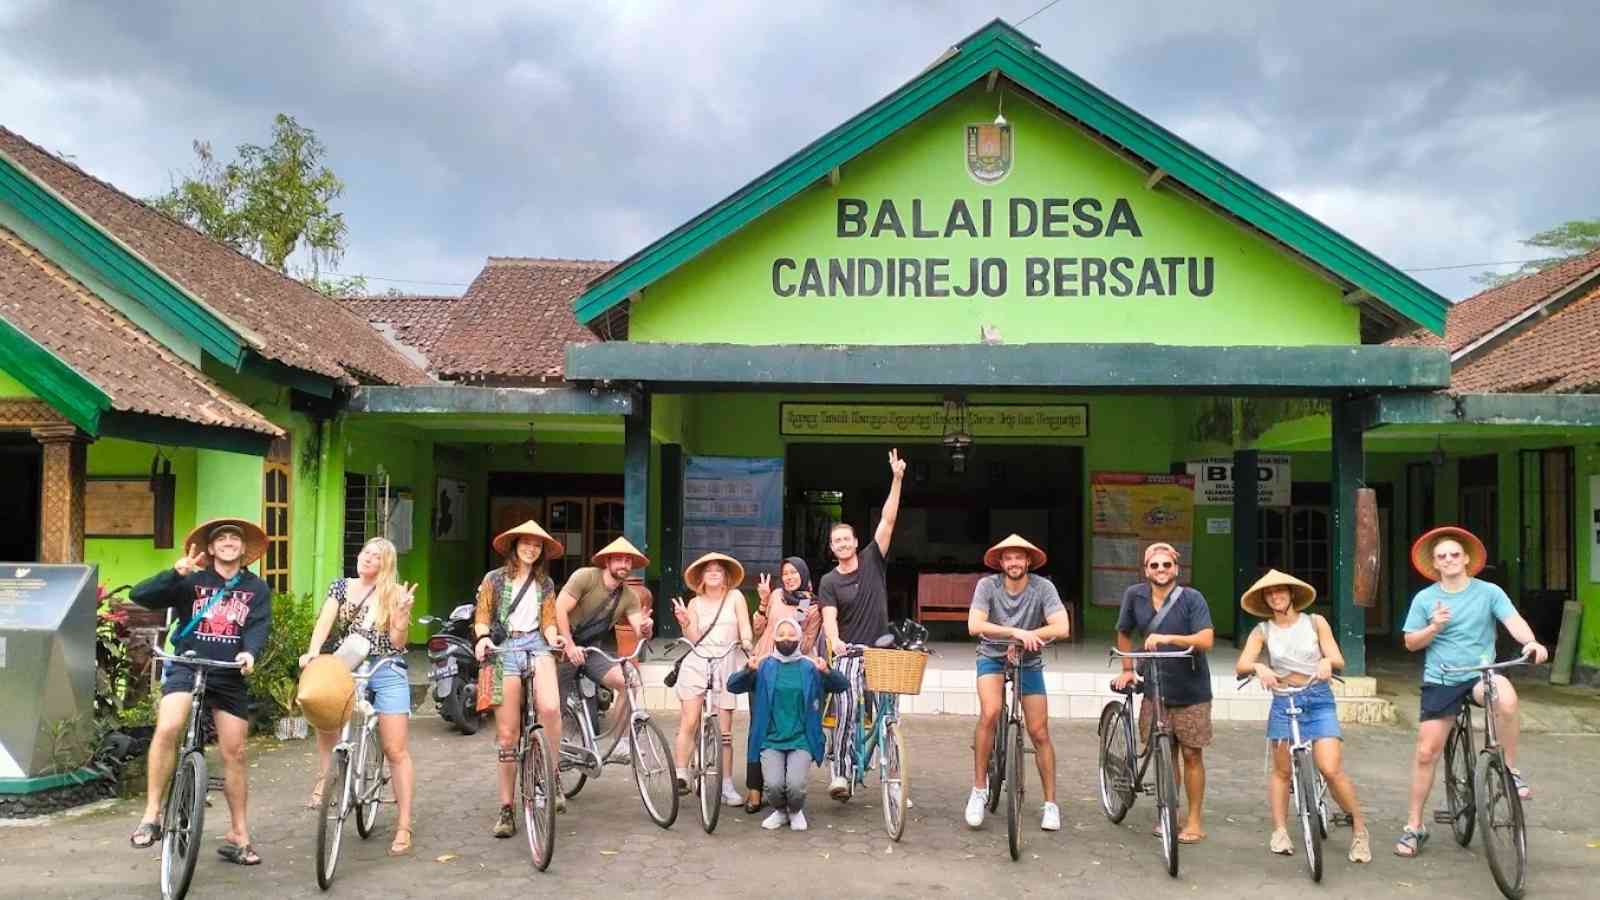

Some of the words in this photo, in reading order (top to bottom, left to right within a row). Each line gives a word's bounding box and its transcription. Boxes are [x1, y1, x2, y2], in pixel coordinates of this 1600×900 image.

[837, 198, 992, 238] BALAI
[1009, 198, 1143, 238] DESA
[772, 257, 1008, 298] CANDIREJO
[1025, 256, 1215, 297] BERSATU
[1207, 466, 1273, 481] BD
